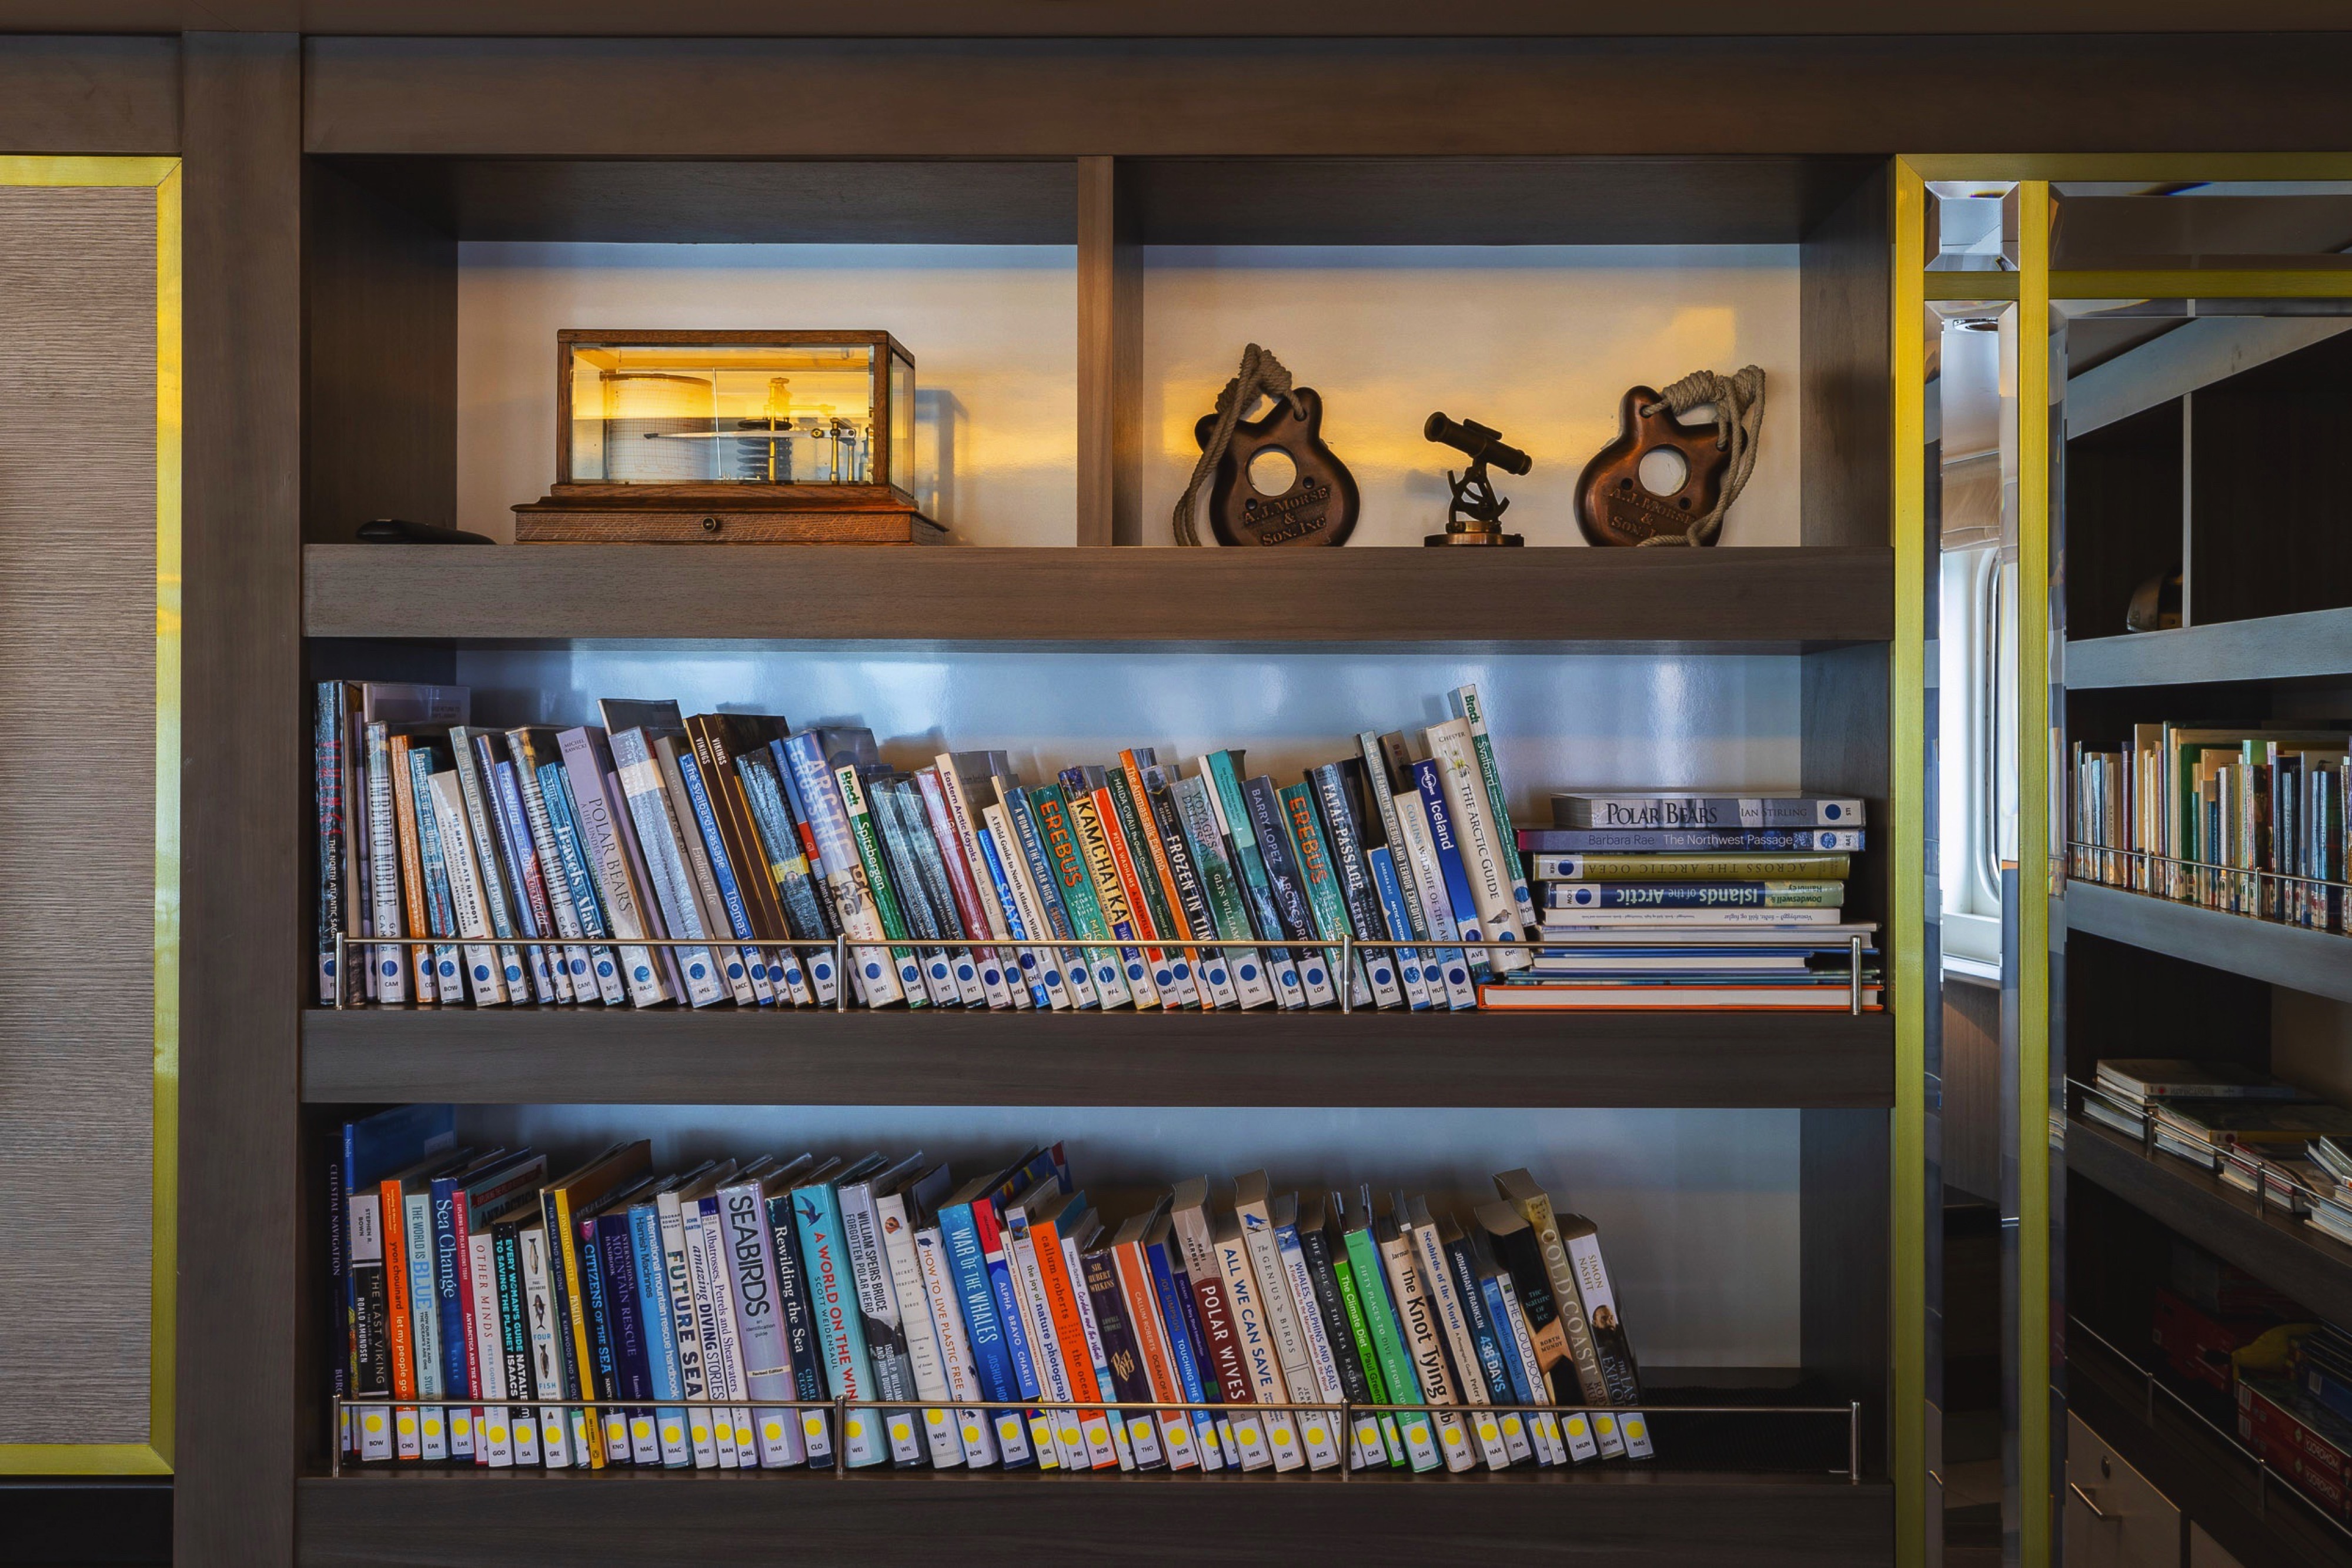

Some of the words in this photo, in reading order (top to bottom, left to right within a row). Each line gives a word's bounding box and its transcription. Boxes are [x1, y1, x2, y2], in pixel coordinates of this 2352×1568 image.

[1277, 488, 1327, 511] MORSE
[1643, 498, 1696, 524] MORSE
[1285, 512, 1296, 524] &
[1642, 513, 1653, 524] &
[1465, 695, 1479, 724] Bradt
[696, 737, 710, 764] VIKINGS
[712, 737, 726, 765] VIKINGS
[1478, 742, 1498, 786] Svalbard
[684, 761, 699, 782] The
[369, 775, 393, 847] UMBERTO
[691, 781, 713, 827] Svalbard
[943, 770, 959, 804] Eastern
[954, 804, 968, 830] Arctic
[961, 830, 978, 862] Kayaks
[1606, 803, 1658, 824] POLAR
[1665, 803, 1717, 823] BEARS
[1741, 808, 1758, 817] IAN
[1016, 814, 1032, 839] WOMAN
[1251, 788, 1270, 826] BARRY
[1263, 828, 1282, 864] LOPEZ
[1288, 796, 1327, 884] EREBUS
[1322, 782, 1346, 827] FATAL
[1334, 827, 1364, 891] PASSAGE
[1431, 800, 1454, 850] Iceland
[588, 797, 617, 856] POLAR
[606, 859, 633, 911] BEARS
[706, 828, 726, 869] Passage
[858, 822, 884, 890] Spitsbergen
[1025, 838, 1035, 848] IN
[1028, 848, 1040, 861] THE
[1040, 800, 1082, 887] EREBUS
[1461, 784, 1475, 809] THE
[1468, 810, 1488, 856] ARCTIC
[1480, 857, 1500, 900] GUIDE
[1589, 835, 1631, 845] Barbara
[1634, 835, 1655, 845] Rae
[1663, 835, 1683, 844] The
[1688, 835, 1743, 845] Northwest
[1748, 835, 1793, 848] Passage
[689, 845, 711, 881] Ending
[1033, 861, 1048, 883] POLAR
[1077, 801, 1127, 922] KAMCHATKA
[1640, 864, 1698, 874] ARCTIC
[1707, 864, 1738, 874] THE
[1747, 863, 1807, 872] ACROSS
[374, 853, 396, 907] NOBILE
[703, 880, 714, 891] in
[1041, 884, 1055, 904] NIGHT
[1669, 890, 1684, 898] the
[1685, 890, 1696, 898] of
[706, 891, 719, 906] Ice
[726, 888, 749, 934] Thomas
[1617, 889, 1664, 905] Arctic
[1699, 888, 1757, 904] Islands
[1471, 950, 1484, 958] AVE
[735, 982, 748, 991] MCC
[330, 1164, 338, 1211] CELESTIAL
[412, 1206, 423, 1220] THE
[436, 1199, 454, 1229] Sea
[331, 1215, 340, 1275] NAVIGATION
[412, 1222, 425, 1249] WORLD
[644, 1215, 662, 1271] International
[813, 1230, 826, 1242] A
[857, 1211, 875, 1249] WILLIAM
[951, 1227, 976, 1257] WAR
[436, 1233, 459, 1298] Change
[476, 1245, 488, 1288] OTHER
[705, 1228, 723, 1282] Albatrosses,
[729, 1196, 770, 1317] SEABIRDS
[773, 1225, 797, 1298] Rewilding
[864, 1249, 881, 1282] SPEIRS
[923, 1249, 937, 1277] HOW
[960, 1257, 977, 1271] OF
[1223, 1246, 1242, 1277] ALL
[371, 1274, 380, 1297] THE
[413, 1261, 432, 1309] BLUE
[583, 1243, 602, 1308] CITIZENS
[816, 1245, 839, 1303] WORLD
[930, 1279, 941, 1294] TO
[963, 1272, 982, 1290] THE
[1340, 1275, 1352, 1292] The
[1400, 1266, 1418, 1293] The
[653, 1273, 668, 1315] mountain
[667, 1250, 696, 1343] FUTURE
[714, 1284, 727, 1315] Petrels
[871, 1282, 888, 1312] BRUCE
[1232, 1279, 1250, 1305] WE
[1539, 1228, 1573, 1296] COLD
[1561, 1299, 1599, 1378] COAST
[373, 1303, 382, 1333] LAST
[396, 1316, 404, 1328] let
[480, 1295, 493, 1338] MINDS
[594, 1310, 603, 1323] OF
[787, 1300, 802, 1323] the
[828, 1306, 844, 1332] ON
[934, 1298, 947, 1319] LIVE
[967, 1290, 998, 1344] WHALES
[1345, 1293, 1362, 1328] Climate
[1405, 1295, 1434, 1344] Knot
[395, 1330, 404, 1343] my
[596, 1325, 606, 1344] THE
[659, 1318, 671, 1348] rescue
[720, 1318, 731, 1335] and
[792, 1328, 807, 1352] Sea
[998, 1281, 1013, 1310] ALPHA
[1007, 1315, 1022, 1346] BRAVO
[1016, 1350, 1033, 1387] CHARLIE
[1240, 1308, 1261, 1345] CAN
[1356, 1328, 1368, 1348] Diet
[834, 1333, 851, 1365] THE
[940, 1321, 957, 1363] PLASTIC
[1201, 1285, 1229, 1341] POLAR
[1218, 1345, 1246, 1400] WIVES
[374, 1340, 385, 1383] VIKING
[396, 1345, 407, 1377] people
[599, 1346, 612, 1373] SEA
[664, 1350, 679, 1398] handbook
[681, 1350, 703, 1396] SEA
[723, 1336, 740, 1392] Shearwaters
[1251, 1346, 1272, 1386] SAVE
[1416, 1344, 1450, 1399] Tying
[399, 1379, 407, 1391] go
[951, 1365, 964, 1390] FREE
